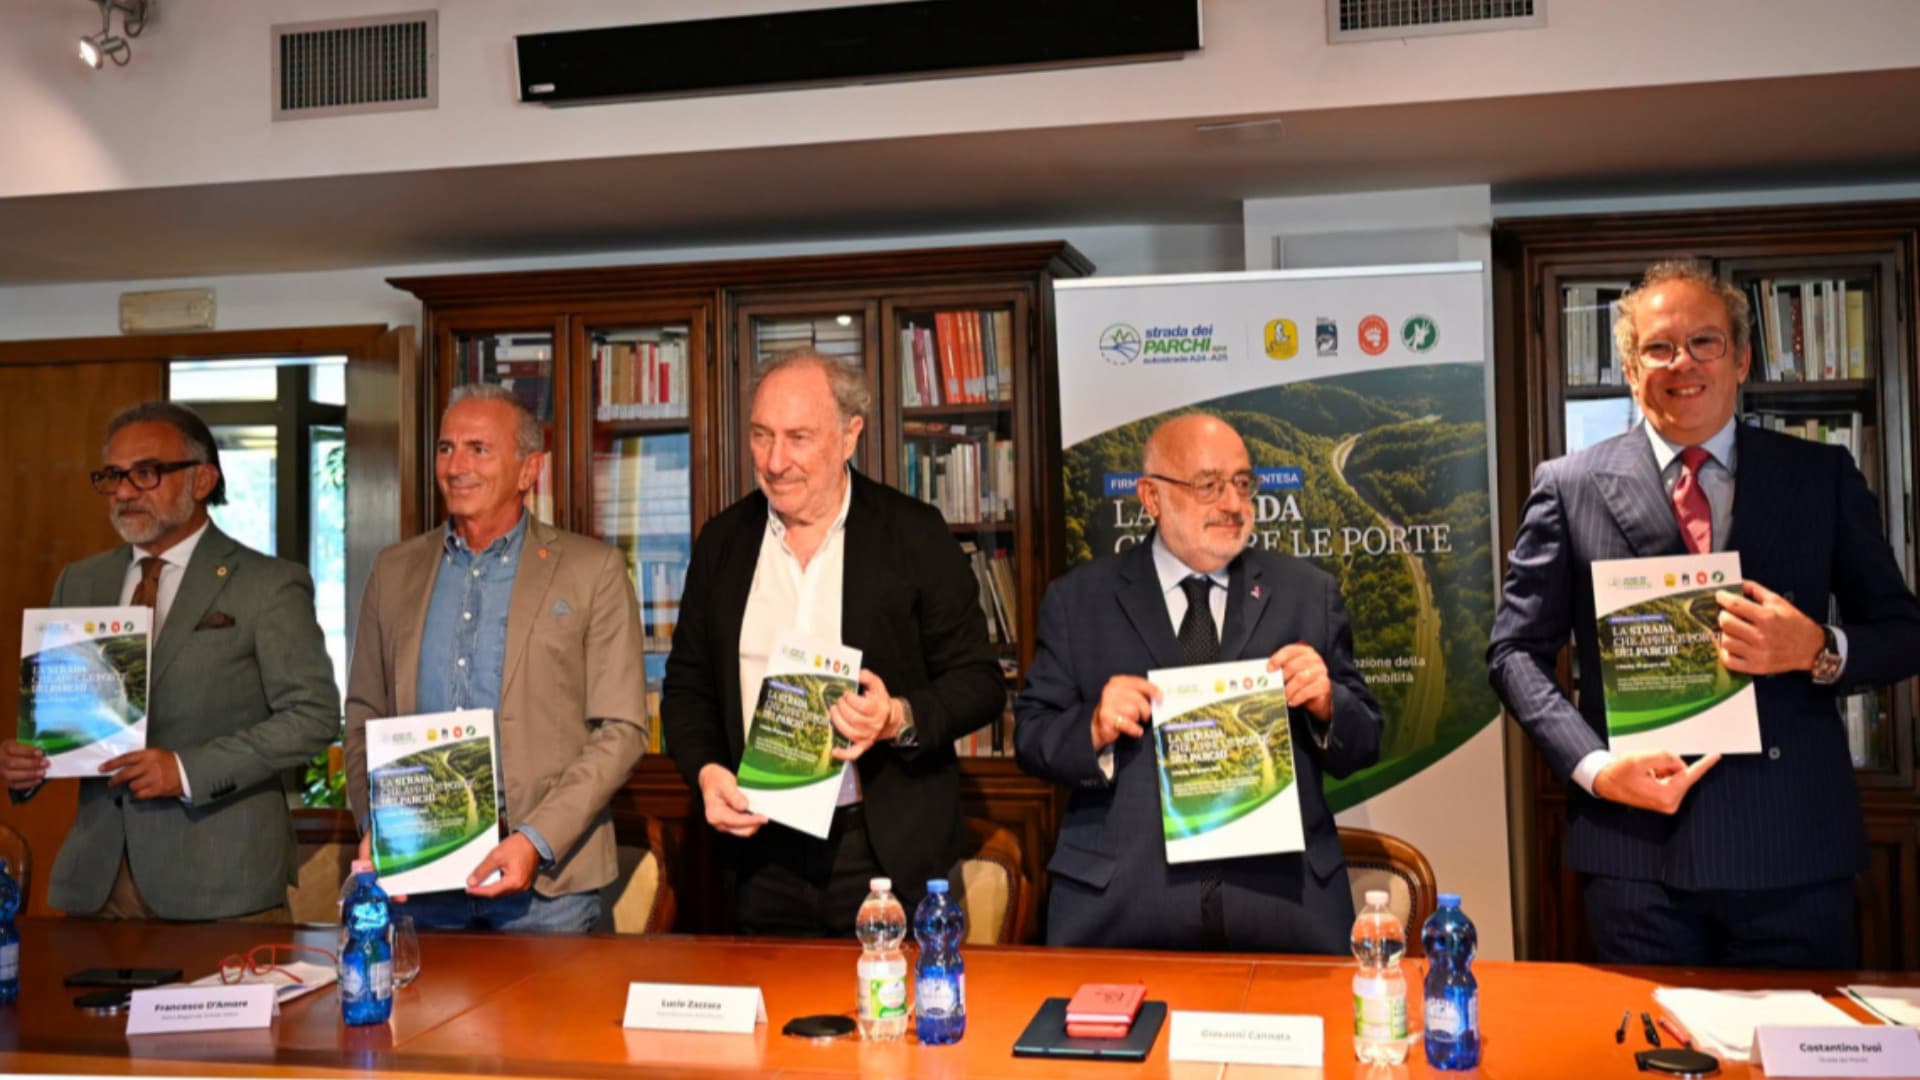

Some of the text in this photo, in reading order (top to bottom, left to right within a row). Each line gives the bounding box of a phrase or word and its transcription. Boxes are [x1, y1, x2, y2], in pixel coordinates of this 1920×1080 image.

[1145, 323, 1213, 338] strada dei
[1143, 337, 1211, 354] PARCHI
[1111, 472, 1300, 489] FIRM NTESA
[1114, 500, 1155, 527] LA
[1293, 528, 1333, 557] LE
[1342, 524, 1452, 556] PORTE
[1394, 656, 1426, 668] della
[1364, 672, 1414, 684] enibilità
[155, 1003, 204, 1011] Francesco
[661, 998, 686, 1008] Lucio
[1201, 1029, 1292, 1041] Giovanni Cannata
[1799, 1043, 1859, 1052] Costantino
